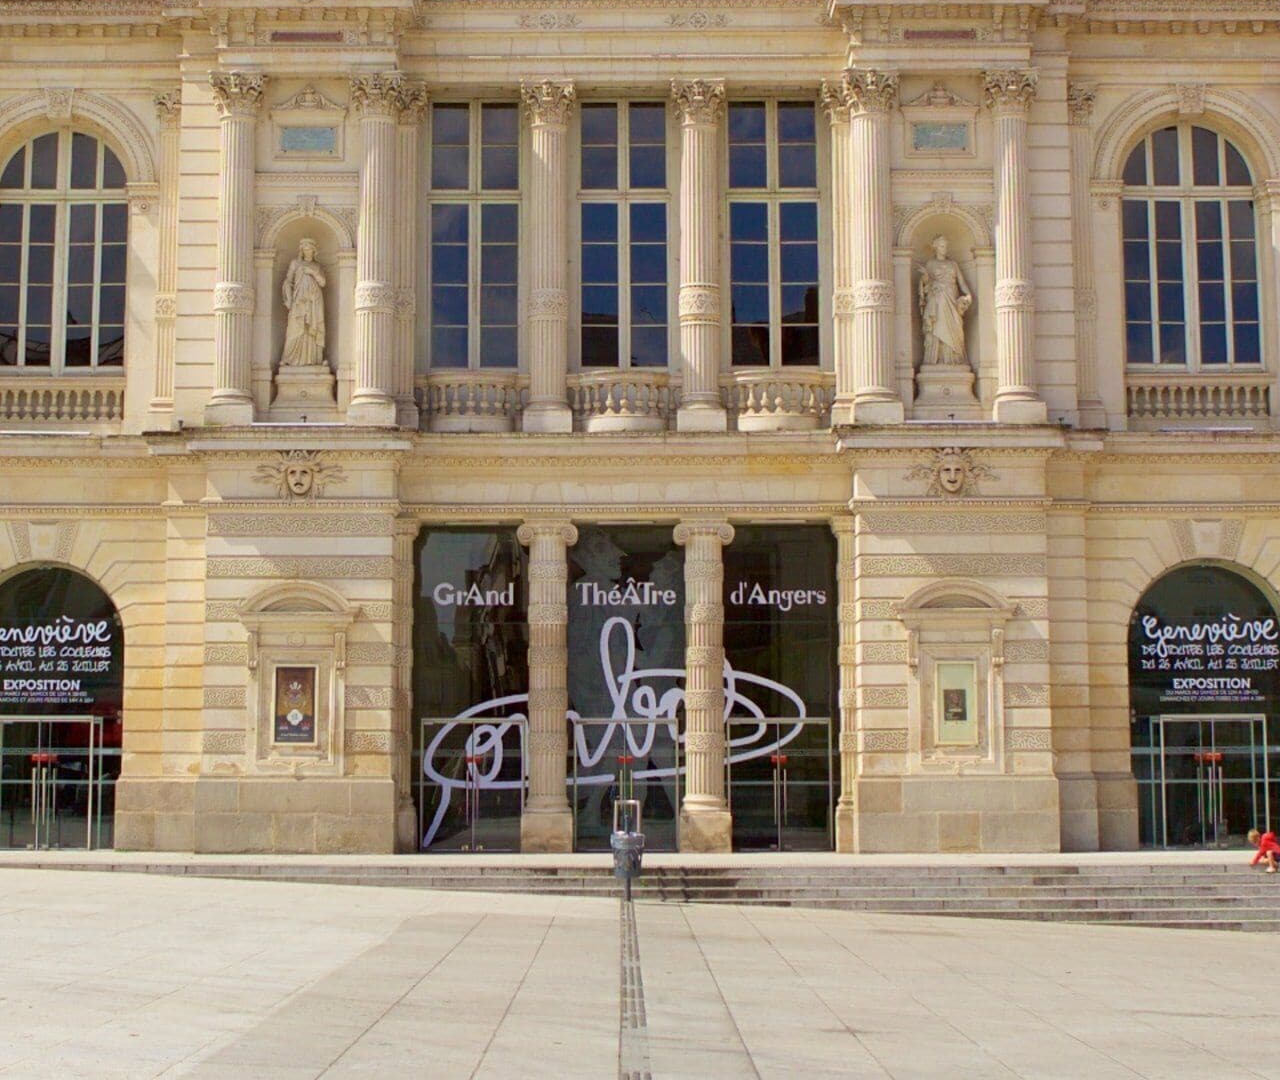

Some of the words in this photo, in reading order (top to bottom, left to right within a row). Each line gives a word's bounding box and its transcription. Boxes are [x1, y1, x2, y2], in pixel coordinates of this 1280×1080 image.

[730, 581, 827, 611] d'Angers
[1142, 612, 1279, 658] Geneviève
[38, 646, 57, 657] LES
[1206, 644, 1224, 655] LES
[3, 679, 81, 690] EXPOSITION
[1172, 678, 1251, 689] EXPOSITION
